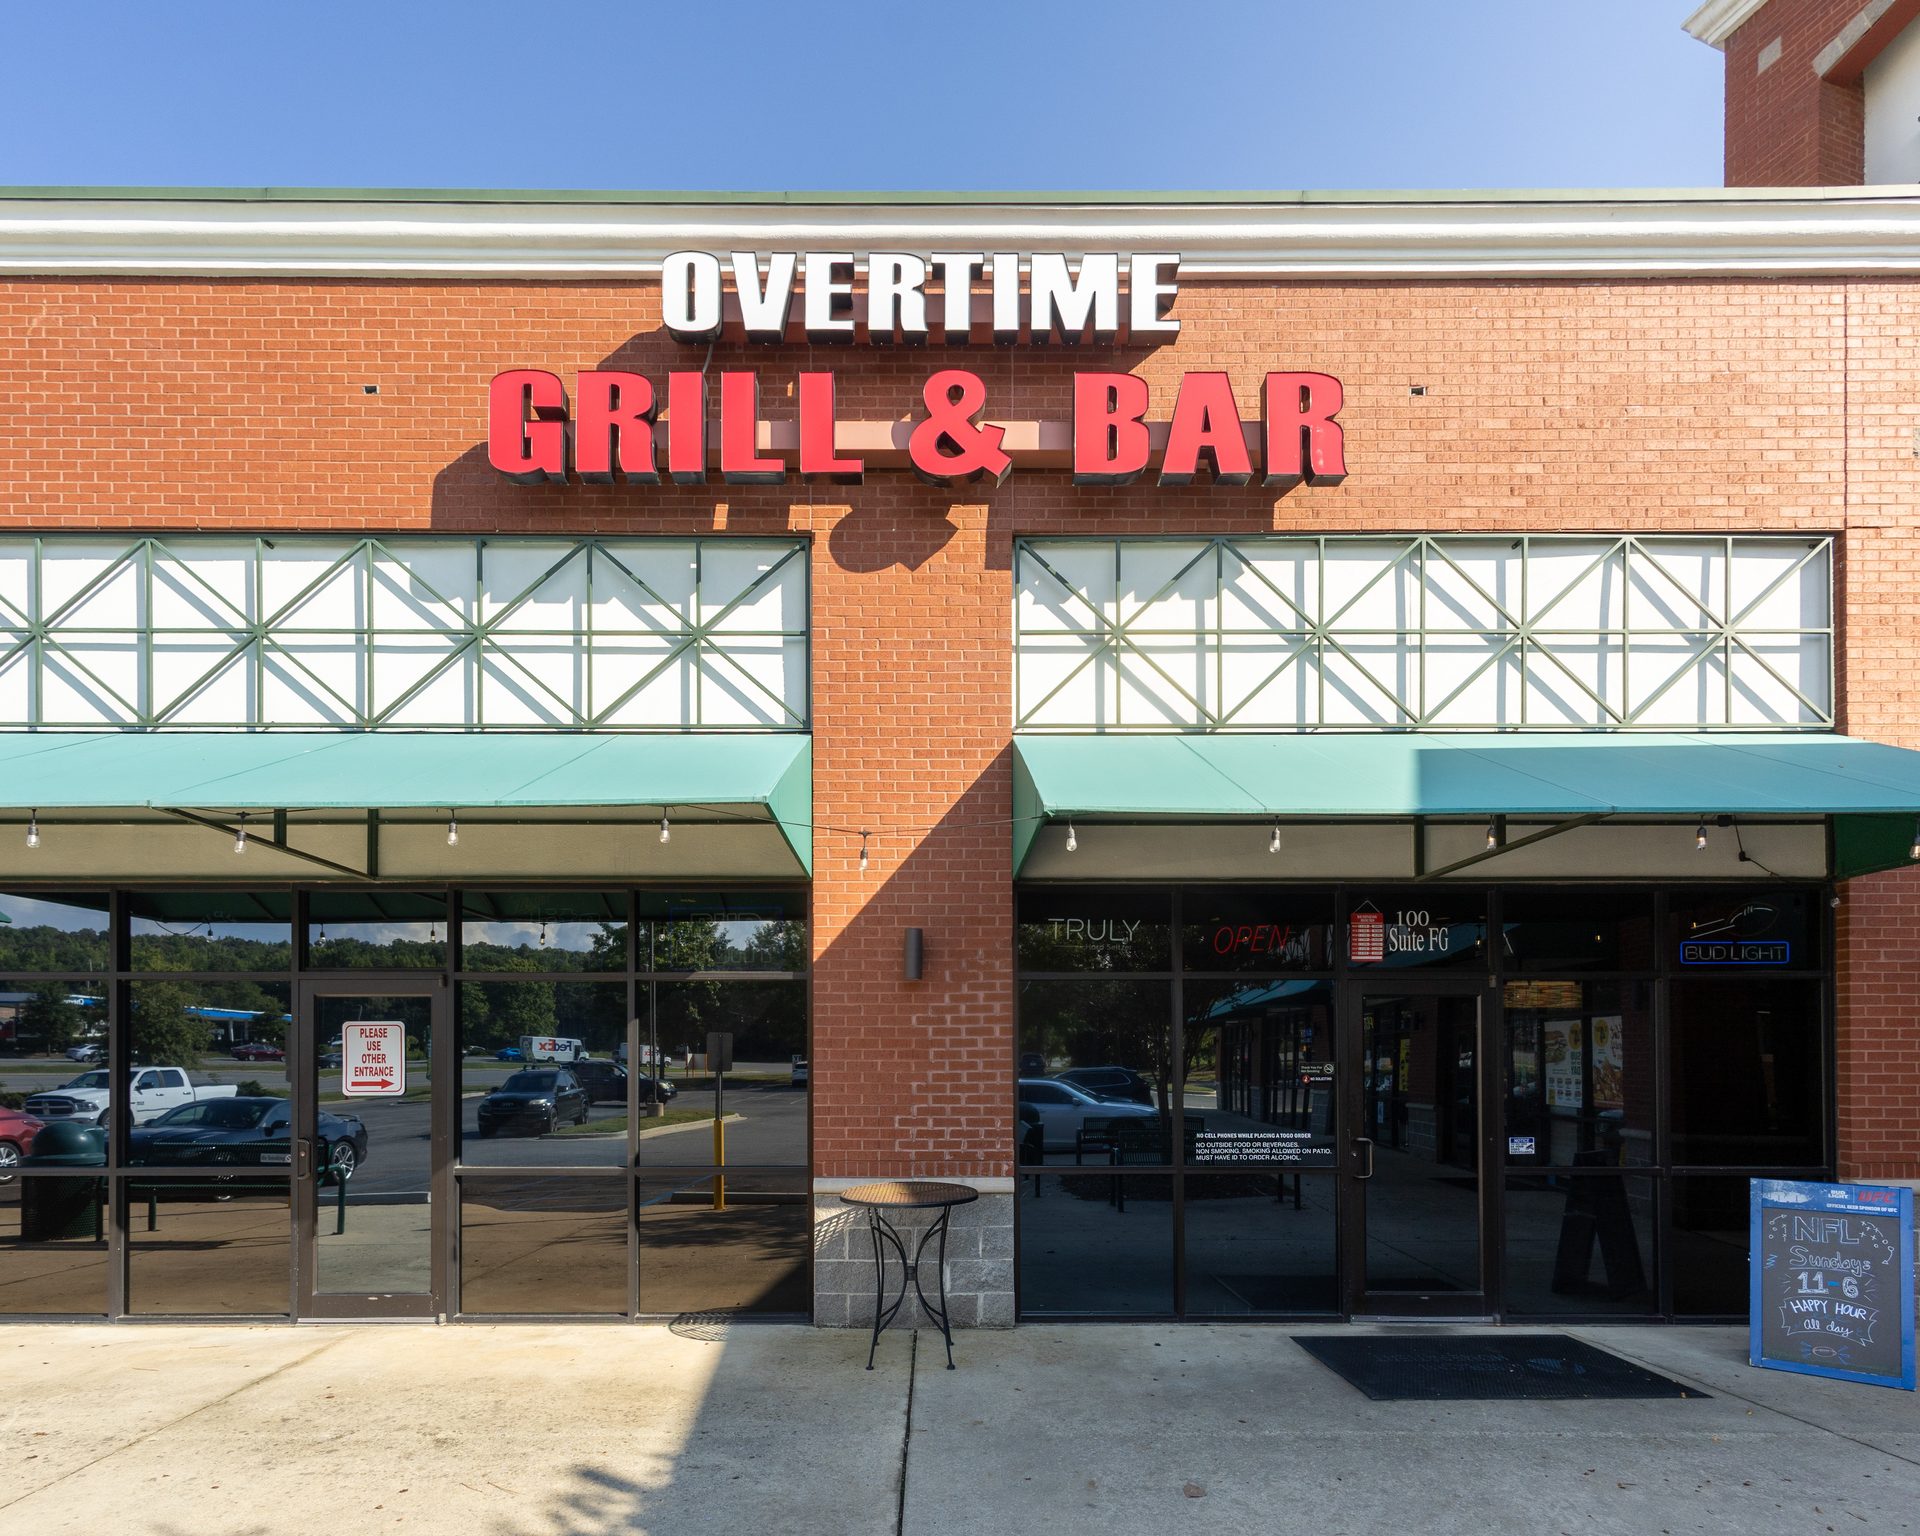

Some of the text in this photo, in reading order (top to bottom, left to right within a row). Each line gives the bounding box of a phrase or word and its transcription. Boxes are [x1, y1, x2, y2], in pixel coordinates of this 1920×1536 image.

[662, 250, 1181, 340] OVERTIME
[488, 369, 1349, 484] GRILL & BAR
[1396, 910, 1430, 927] 100
[1047, 918, 1141, 943] TRULY
[1213, 923, 1291, 954] OPEN
[1389, 927, 1425, 952] Suite
[1428, 927, 1449, 952] FG
[1685, 945, 1785, 961] BUD LIGHT
[360, 1028, 388, 1038] PLEASE
[366, 1041, 381, 1051] USE
[361, 1053, 386, 1064] OTHER
[354, 1066, 394, 1077] ENTRANCE
[1857, 1190, 1897, 1204] UFC
[1794, 1216, 1860, 1245] NFL
[1789, 1245, 1871, 1277] Sundays
[1789, 1299, 1867, 1320] HAPPY HOUR
[1803, 1318, 1854, 1337] all day
